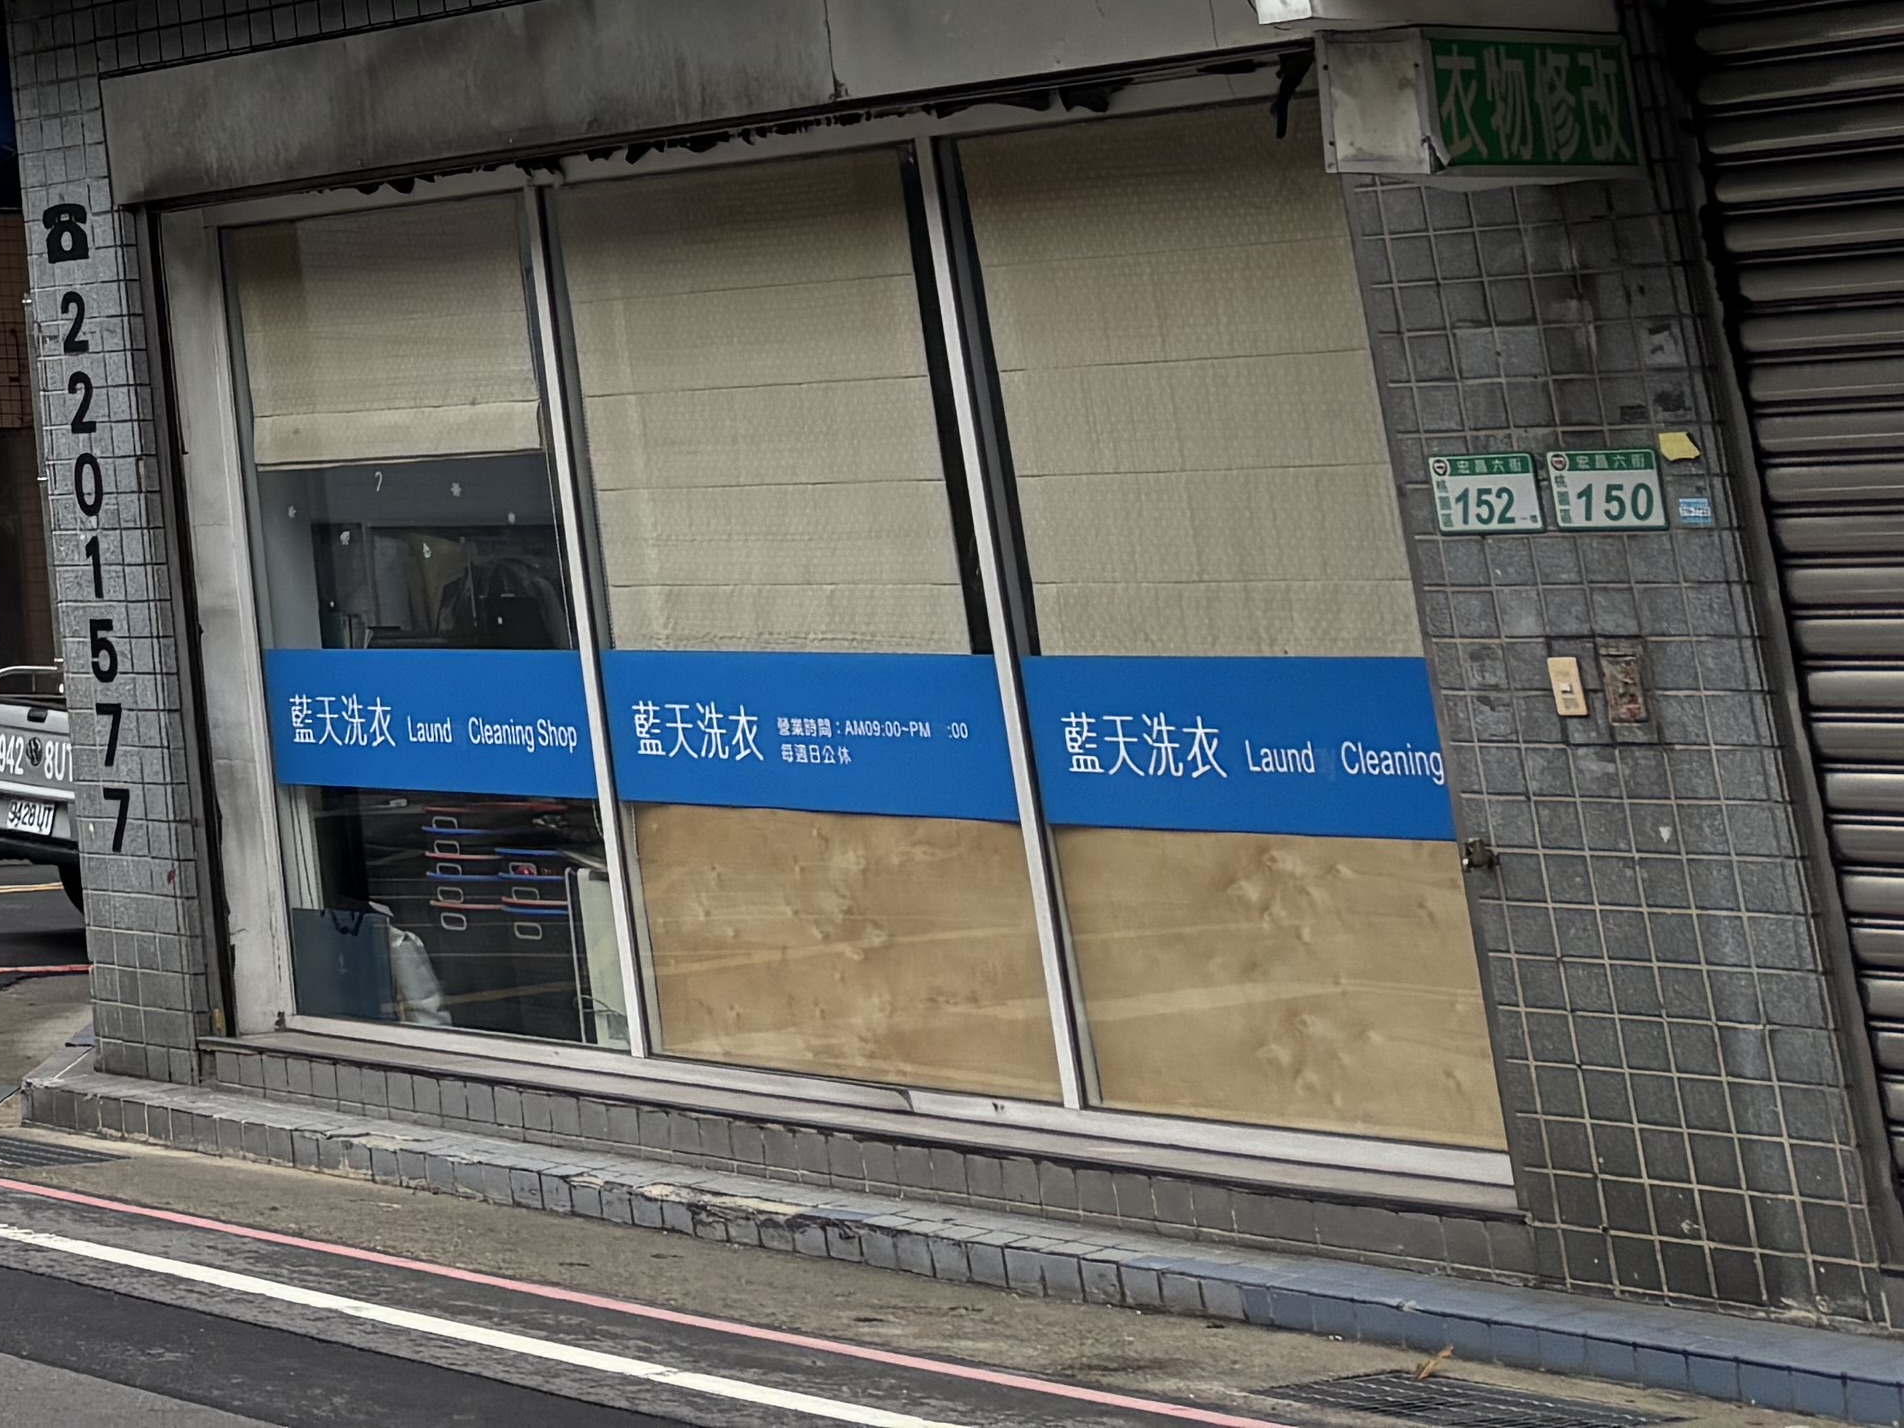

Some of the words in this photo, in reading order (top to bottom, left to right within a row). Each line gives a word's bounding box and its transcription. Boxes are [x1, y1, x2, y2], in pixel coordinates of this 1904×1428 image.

[1436, 46, 1629, 161] 衣物修改
[1455, 486, 1516, 526] 152
[1576, 482, 1654, 522] 150
[61, 292, 129, 852] 2201577
[289, 694, 396, 747] 藍天洗衣
[408, 716, 452, 743] Laund
[468, 716, 534, 752] Cleaning
[537, 718, 577, 753] Shop
[632, 700, 764, 762] 藍天洗衣
[1061, 712, 1228, 779] 藍天洗衣
[1245, 740, 1316, 775] Laund
[1341, 741, 1445, 785] Cleaning
